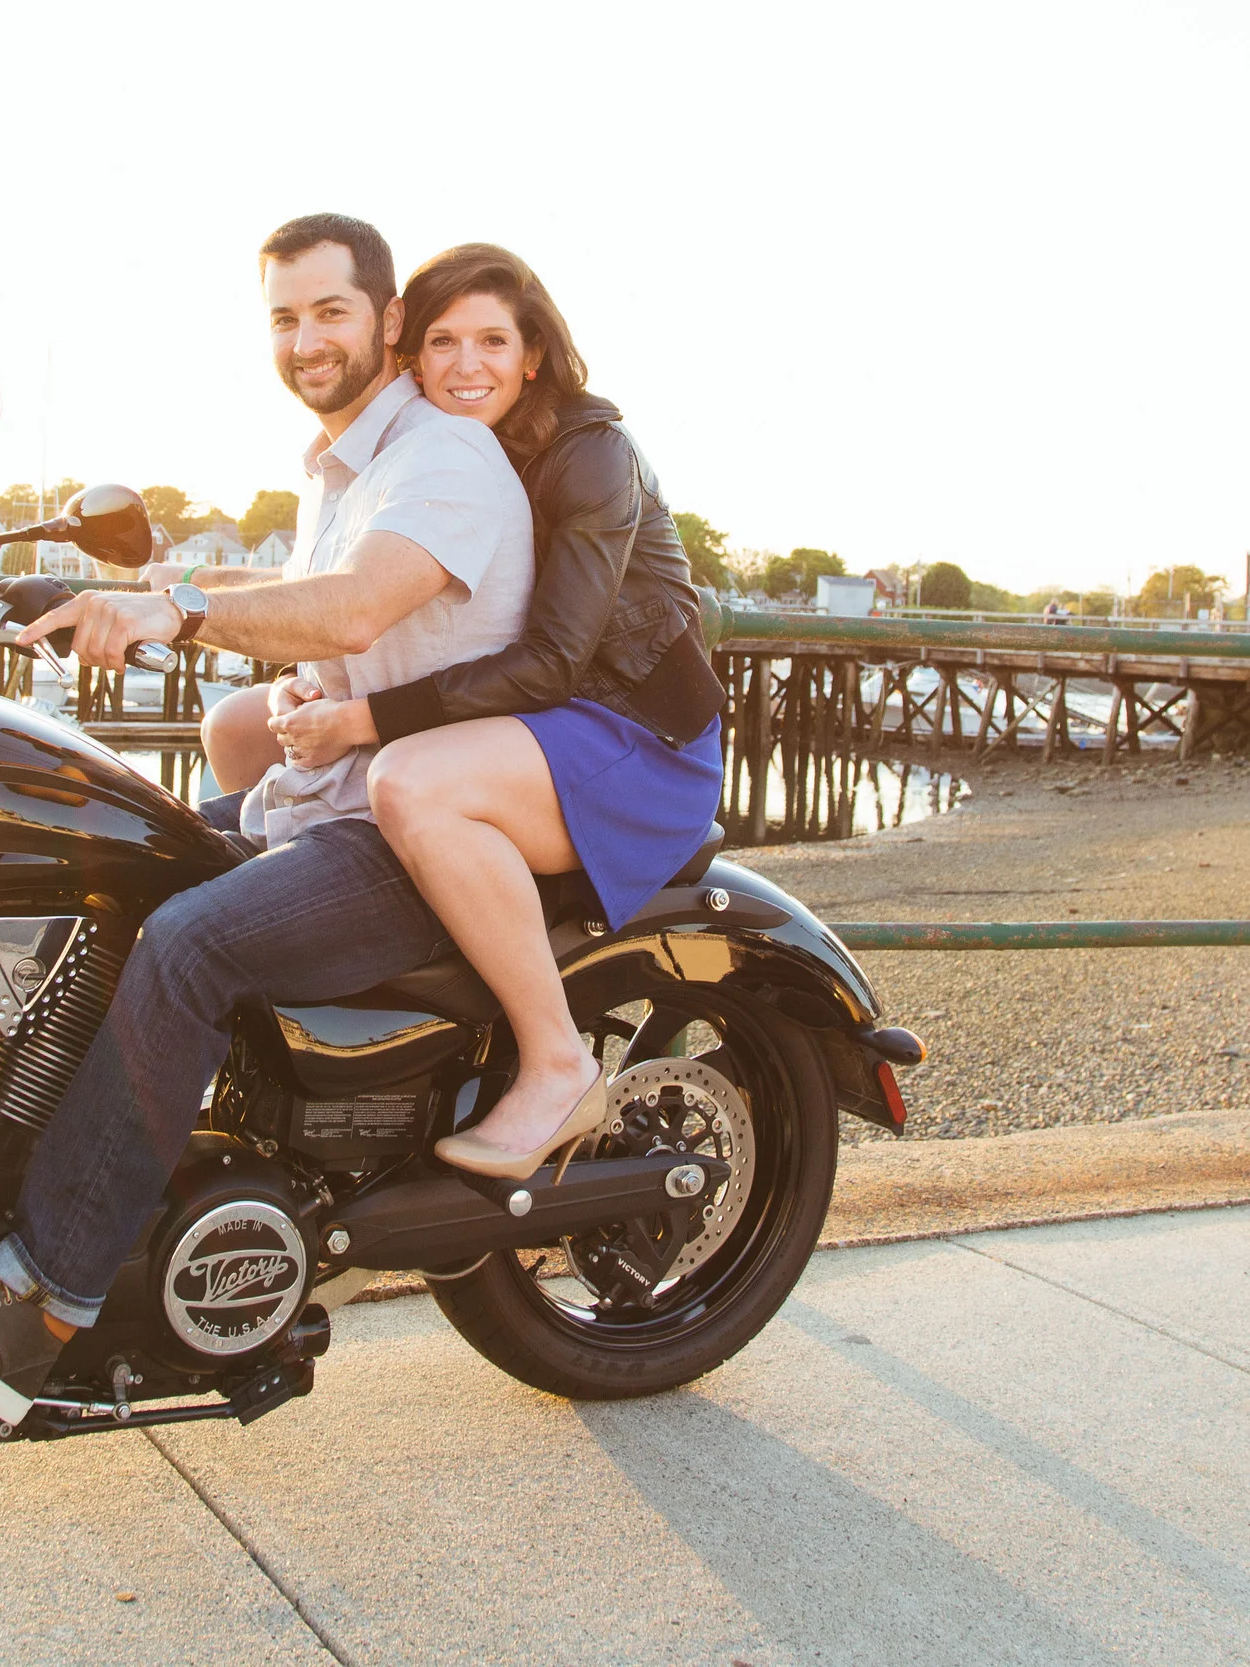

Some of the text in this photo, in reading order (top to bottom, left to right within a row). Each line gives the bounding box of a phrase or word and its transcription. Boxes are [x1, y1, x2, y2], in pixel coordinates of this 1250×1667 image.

[218, 1219, 263, 1236] MADE IN
[190, 1256, 288, 1302] Victory
[618, 1257, 651, 1287] VICTORY
[196, 1315, 271, 1338] THE U.S.A.
